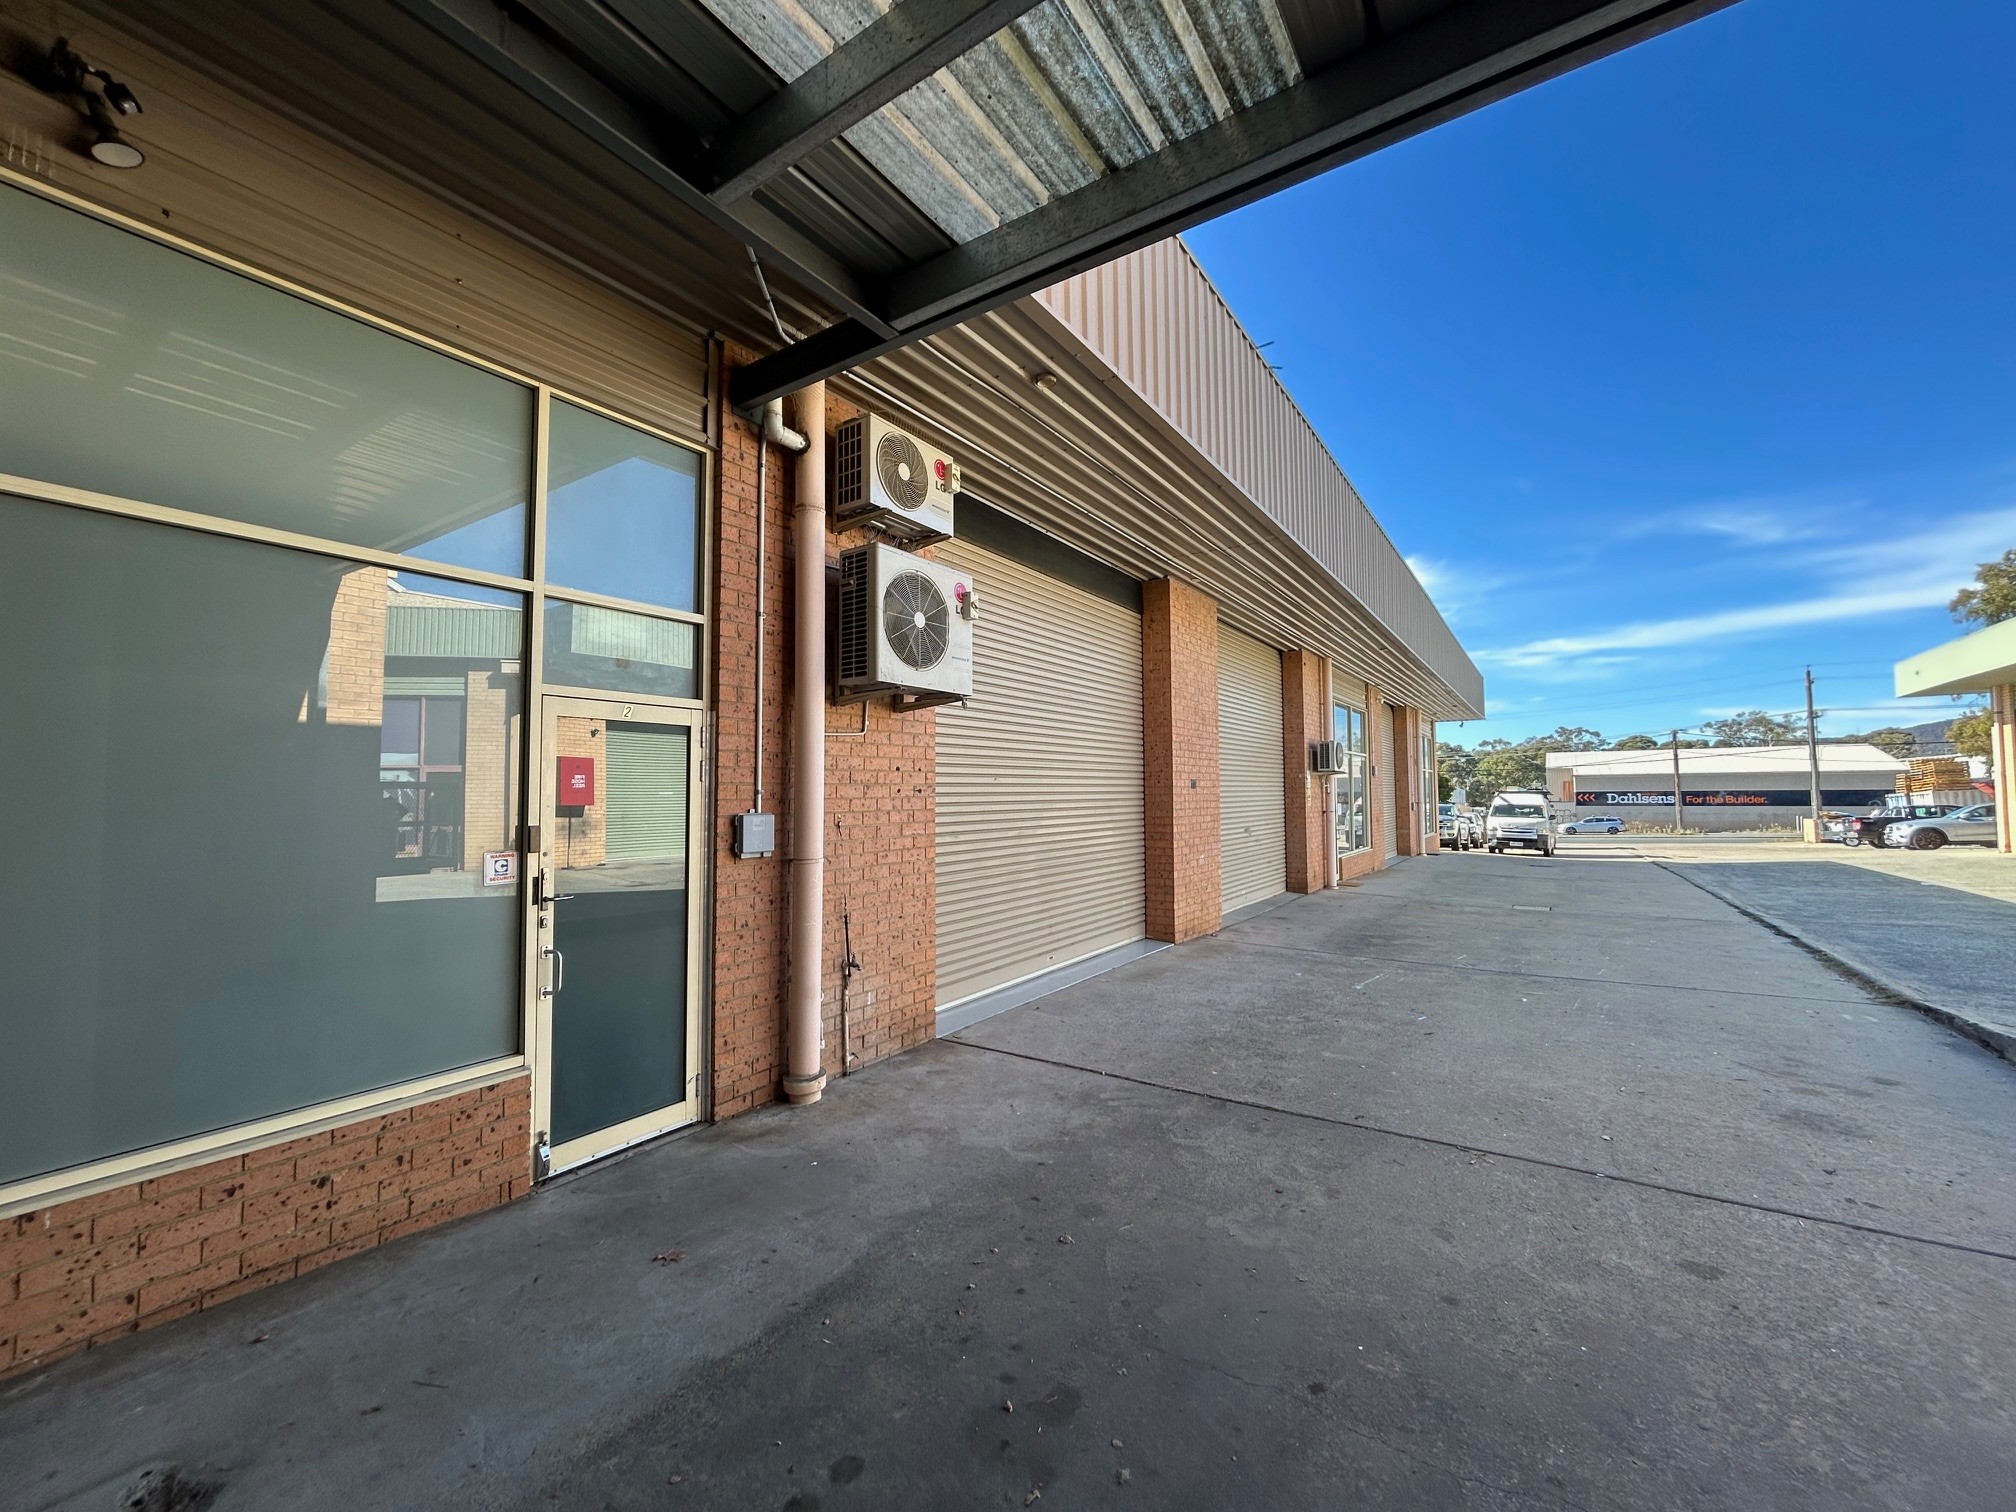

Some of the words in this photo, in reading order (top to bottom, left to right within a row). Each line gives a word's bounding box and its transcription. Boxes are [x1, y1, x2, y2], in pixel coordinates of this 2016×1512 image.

[624, 706, 632, 718] 2
[1606, 792, 1676, 804] Dahlsens
[1686, 795, 1705, 804] For
[1706, 795, 1724, 804] the
[1725, 795, 1768, 804] Builder.
